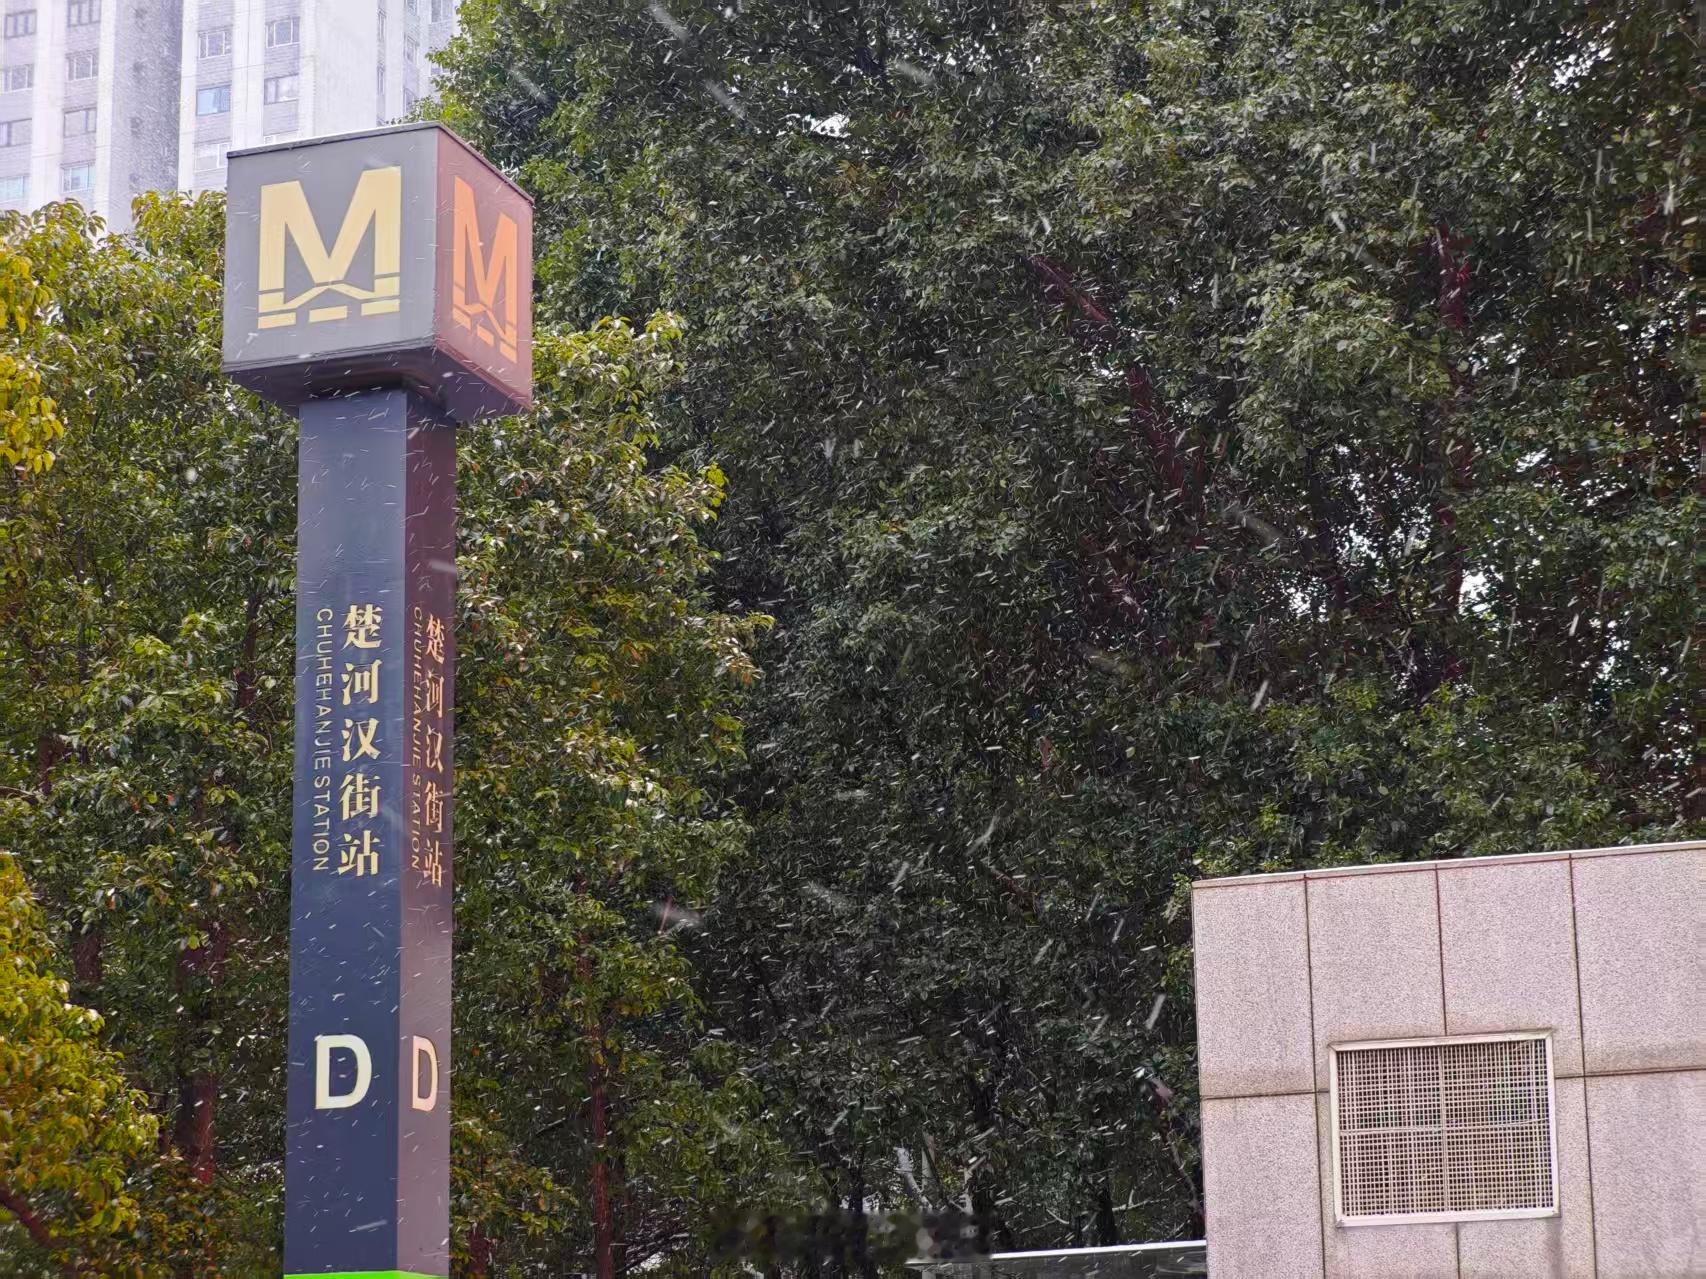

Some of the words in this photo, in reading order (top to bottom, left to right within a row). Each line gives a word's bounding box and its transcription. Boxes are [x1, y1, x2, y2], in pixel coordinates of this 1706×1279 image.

[314, 608, 333, 770] CHUHEHANJIE
[337, 603, 383, 877] 楚河汉街站
[412, 606, 424, 768] CHUHEHANJIE
[423, 612, 446, 888] 楚河汉街站
[313, 775, 331, 871] STATION
[411, 774, 422, 869] STATION
[315, 1034, 372, 1110] D
[412, 1035, 439, 1112] D
